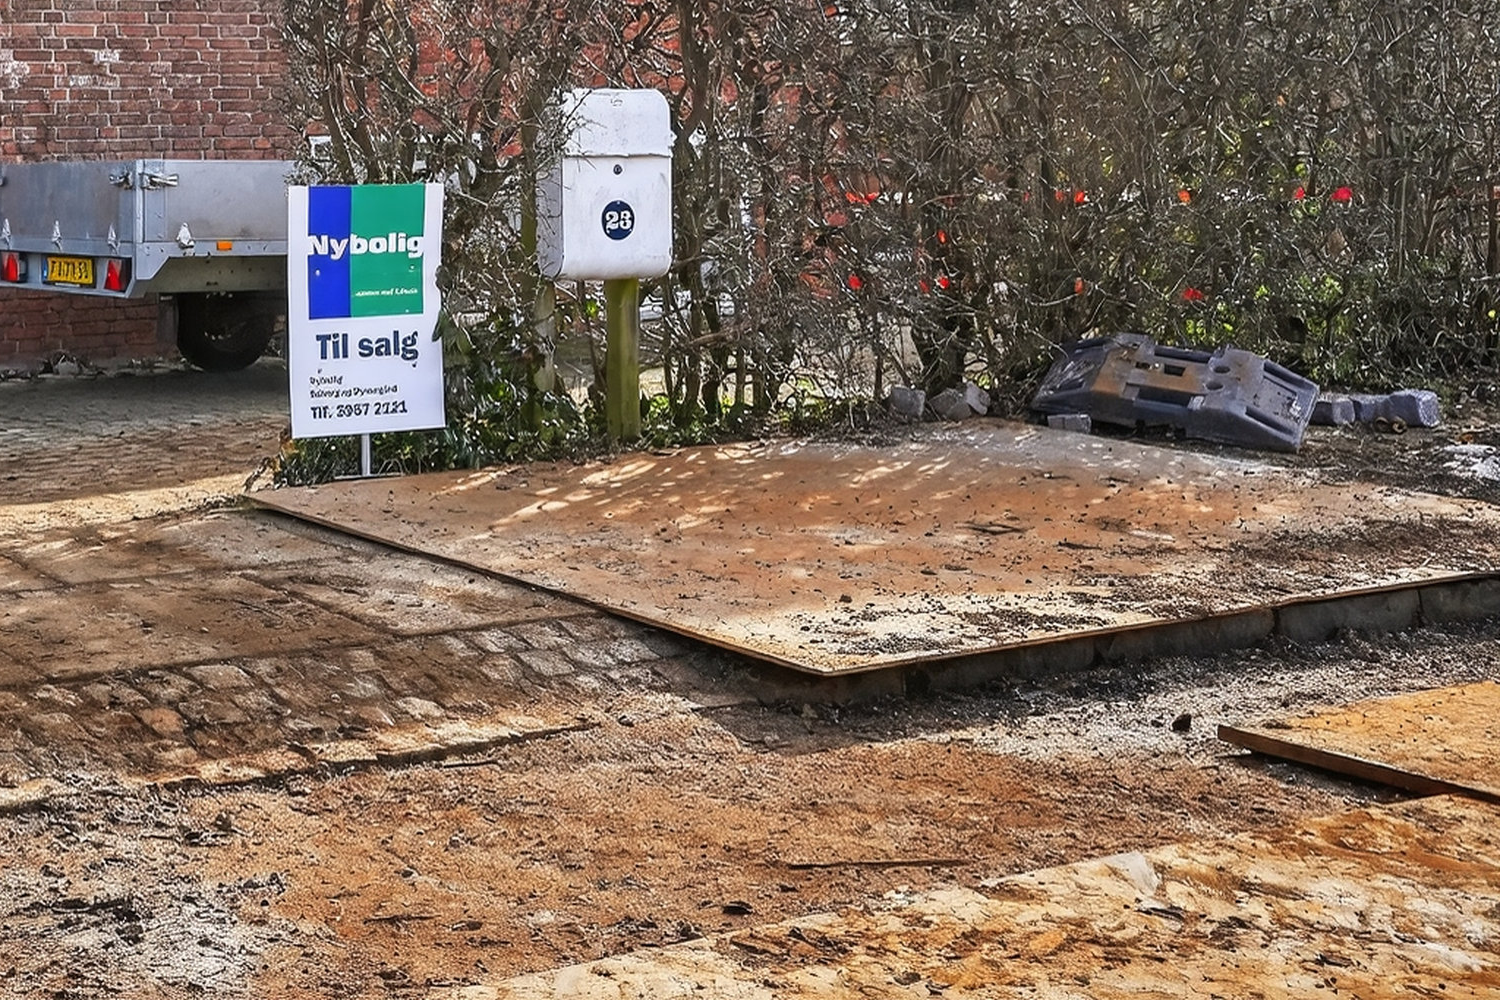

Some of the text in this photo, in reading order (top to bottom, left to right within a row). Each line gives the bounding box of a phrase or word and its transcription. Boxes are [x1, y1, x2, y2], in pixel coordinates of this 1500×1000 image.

[605, 210, 632, 231] 23
[307, 232, 424, 260] Nybolig
[316, 330, 419, 362] Til salg
